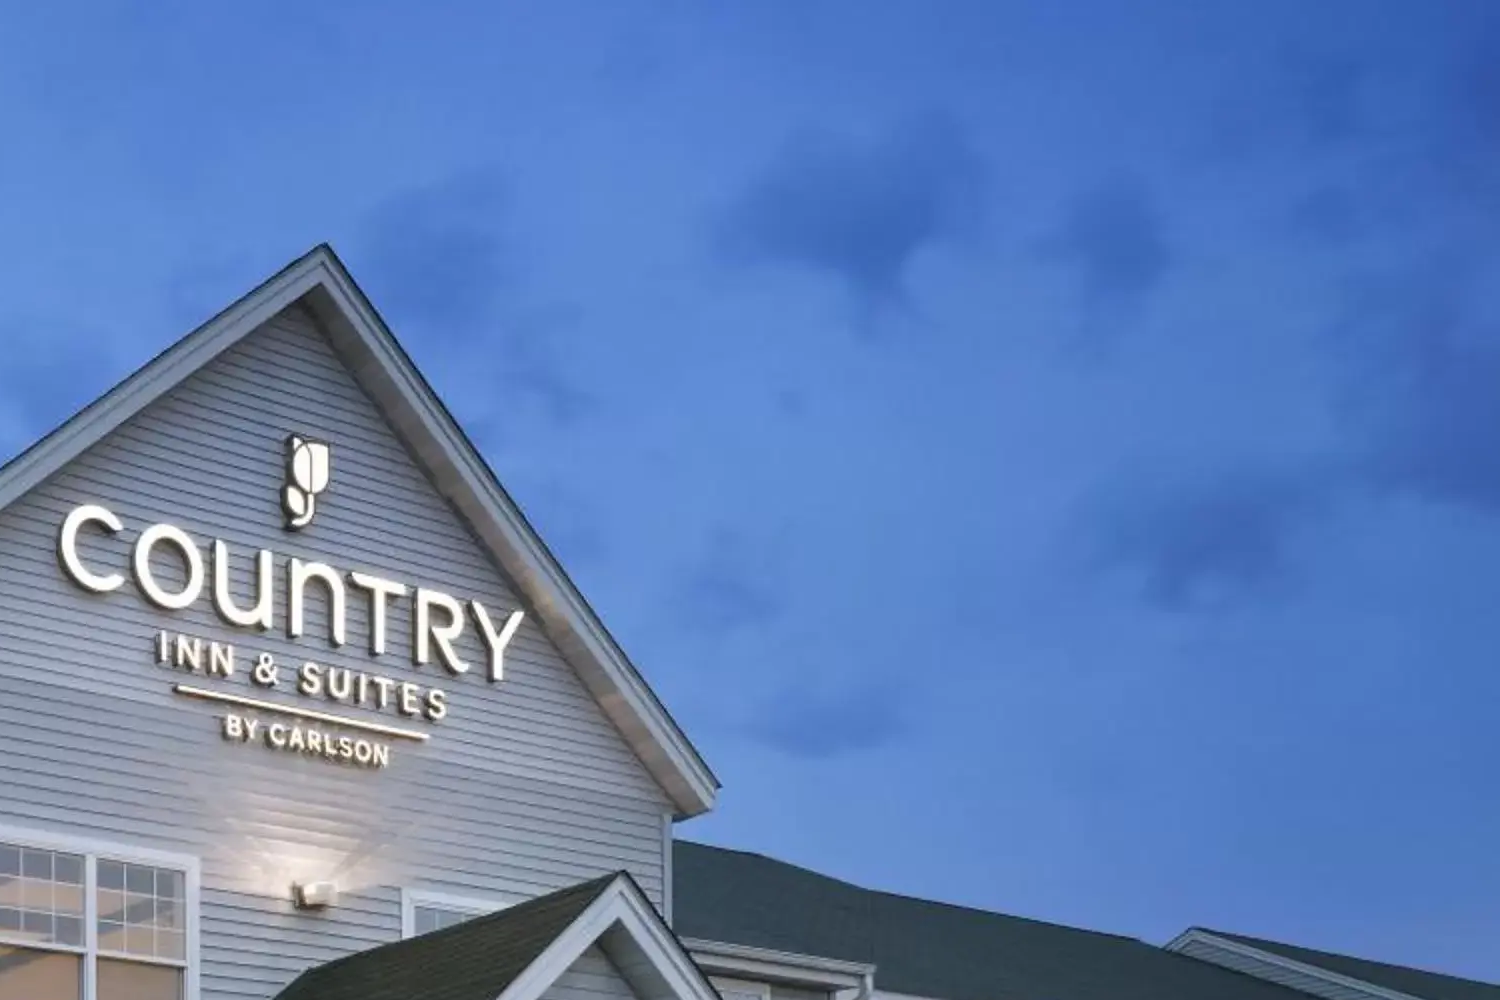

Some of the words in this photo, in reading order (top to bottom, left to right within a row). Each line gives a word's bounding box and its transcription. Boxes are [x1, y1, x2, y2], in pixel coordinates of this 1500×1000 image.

[155, 631, 235, 676] INN
[252, 653, 279, 686] &
[299, 662, 447, 721] SUITES
[225, 714, 258, 740] BY
[267, 723, 390, 768] CARLSON
